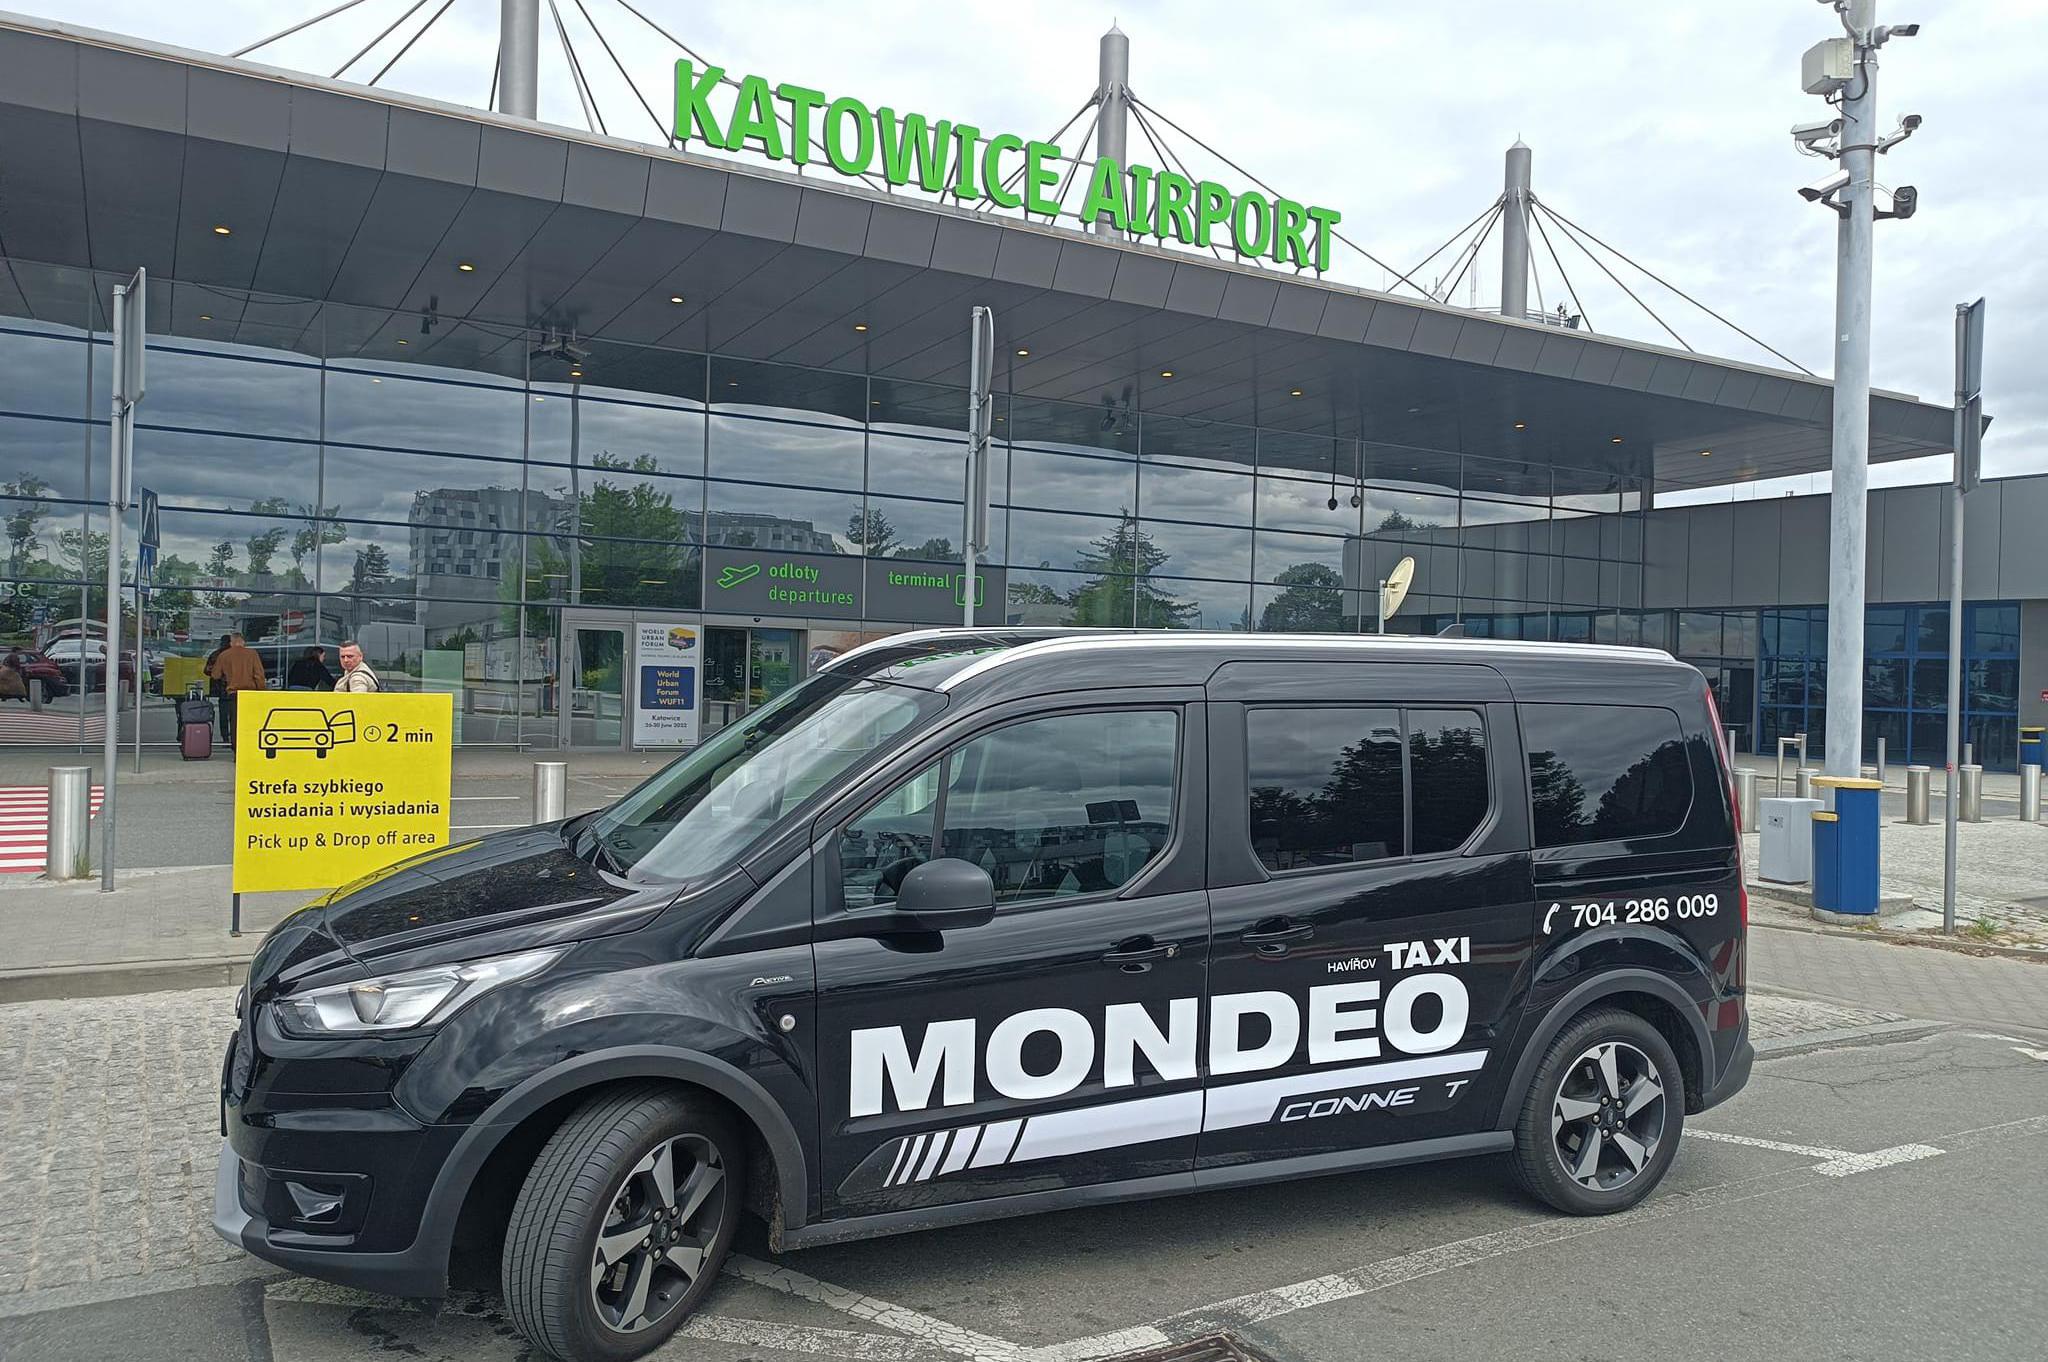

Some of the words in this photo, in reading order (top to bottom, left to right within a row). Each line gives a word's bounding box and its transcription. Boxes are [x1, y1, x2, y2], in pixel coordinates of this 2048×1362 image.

[674, 58, 1061, 217] KATOWICE
[1079, 156, 1341, 271] AIRPORT
[768, 563, 819, 583] odloty
[888, 571, 950, 588] terminal
[768, 586, 853, 605] departures
[656, 670, 680, 678] World
[656, 679, 679, 687] Urban
[656, 688, 679, 696] Forum
[386, 723, 399, 743] 2
[405, 729, 433, 743] min
[248, 779, 297, 795] Strefa
[303, 779, 384, 797] szybkiego
[248, 802, 334, 818] wsiadania
[339, 802, 344, 816] i
[350, 800, 439, 819] wysiadania
[248, 834, 282, 849] Pick
[288, 836, 309, 851] up
[315, 832, 327, 847] &
[333, 832, 370, 849] Drop
[376, 831, 398, 845] off
[402, 832, 435, 844] area
[1571, 903, 1616, 928] 704
[1625, 899, 1669, 923] 286
[1677, 894, 1719, 919] 009
[1327, 957, 1377, 973] HAVÍŘOV
[1383, 936, 1471, 970] TAXI
[850, 973, 1469, 1118] MONDEO
